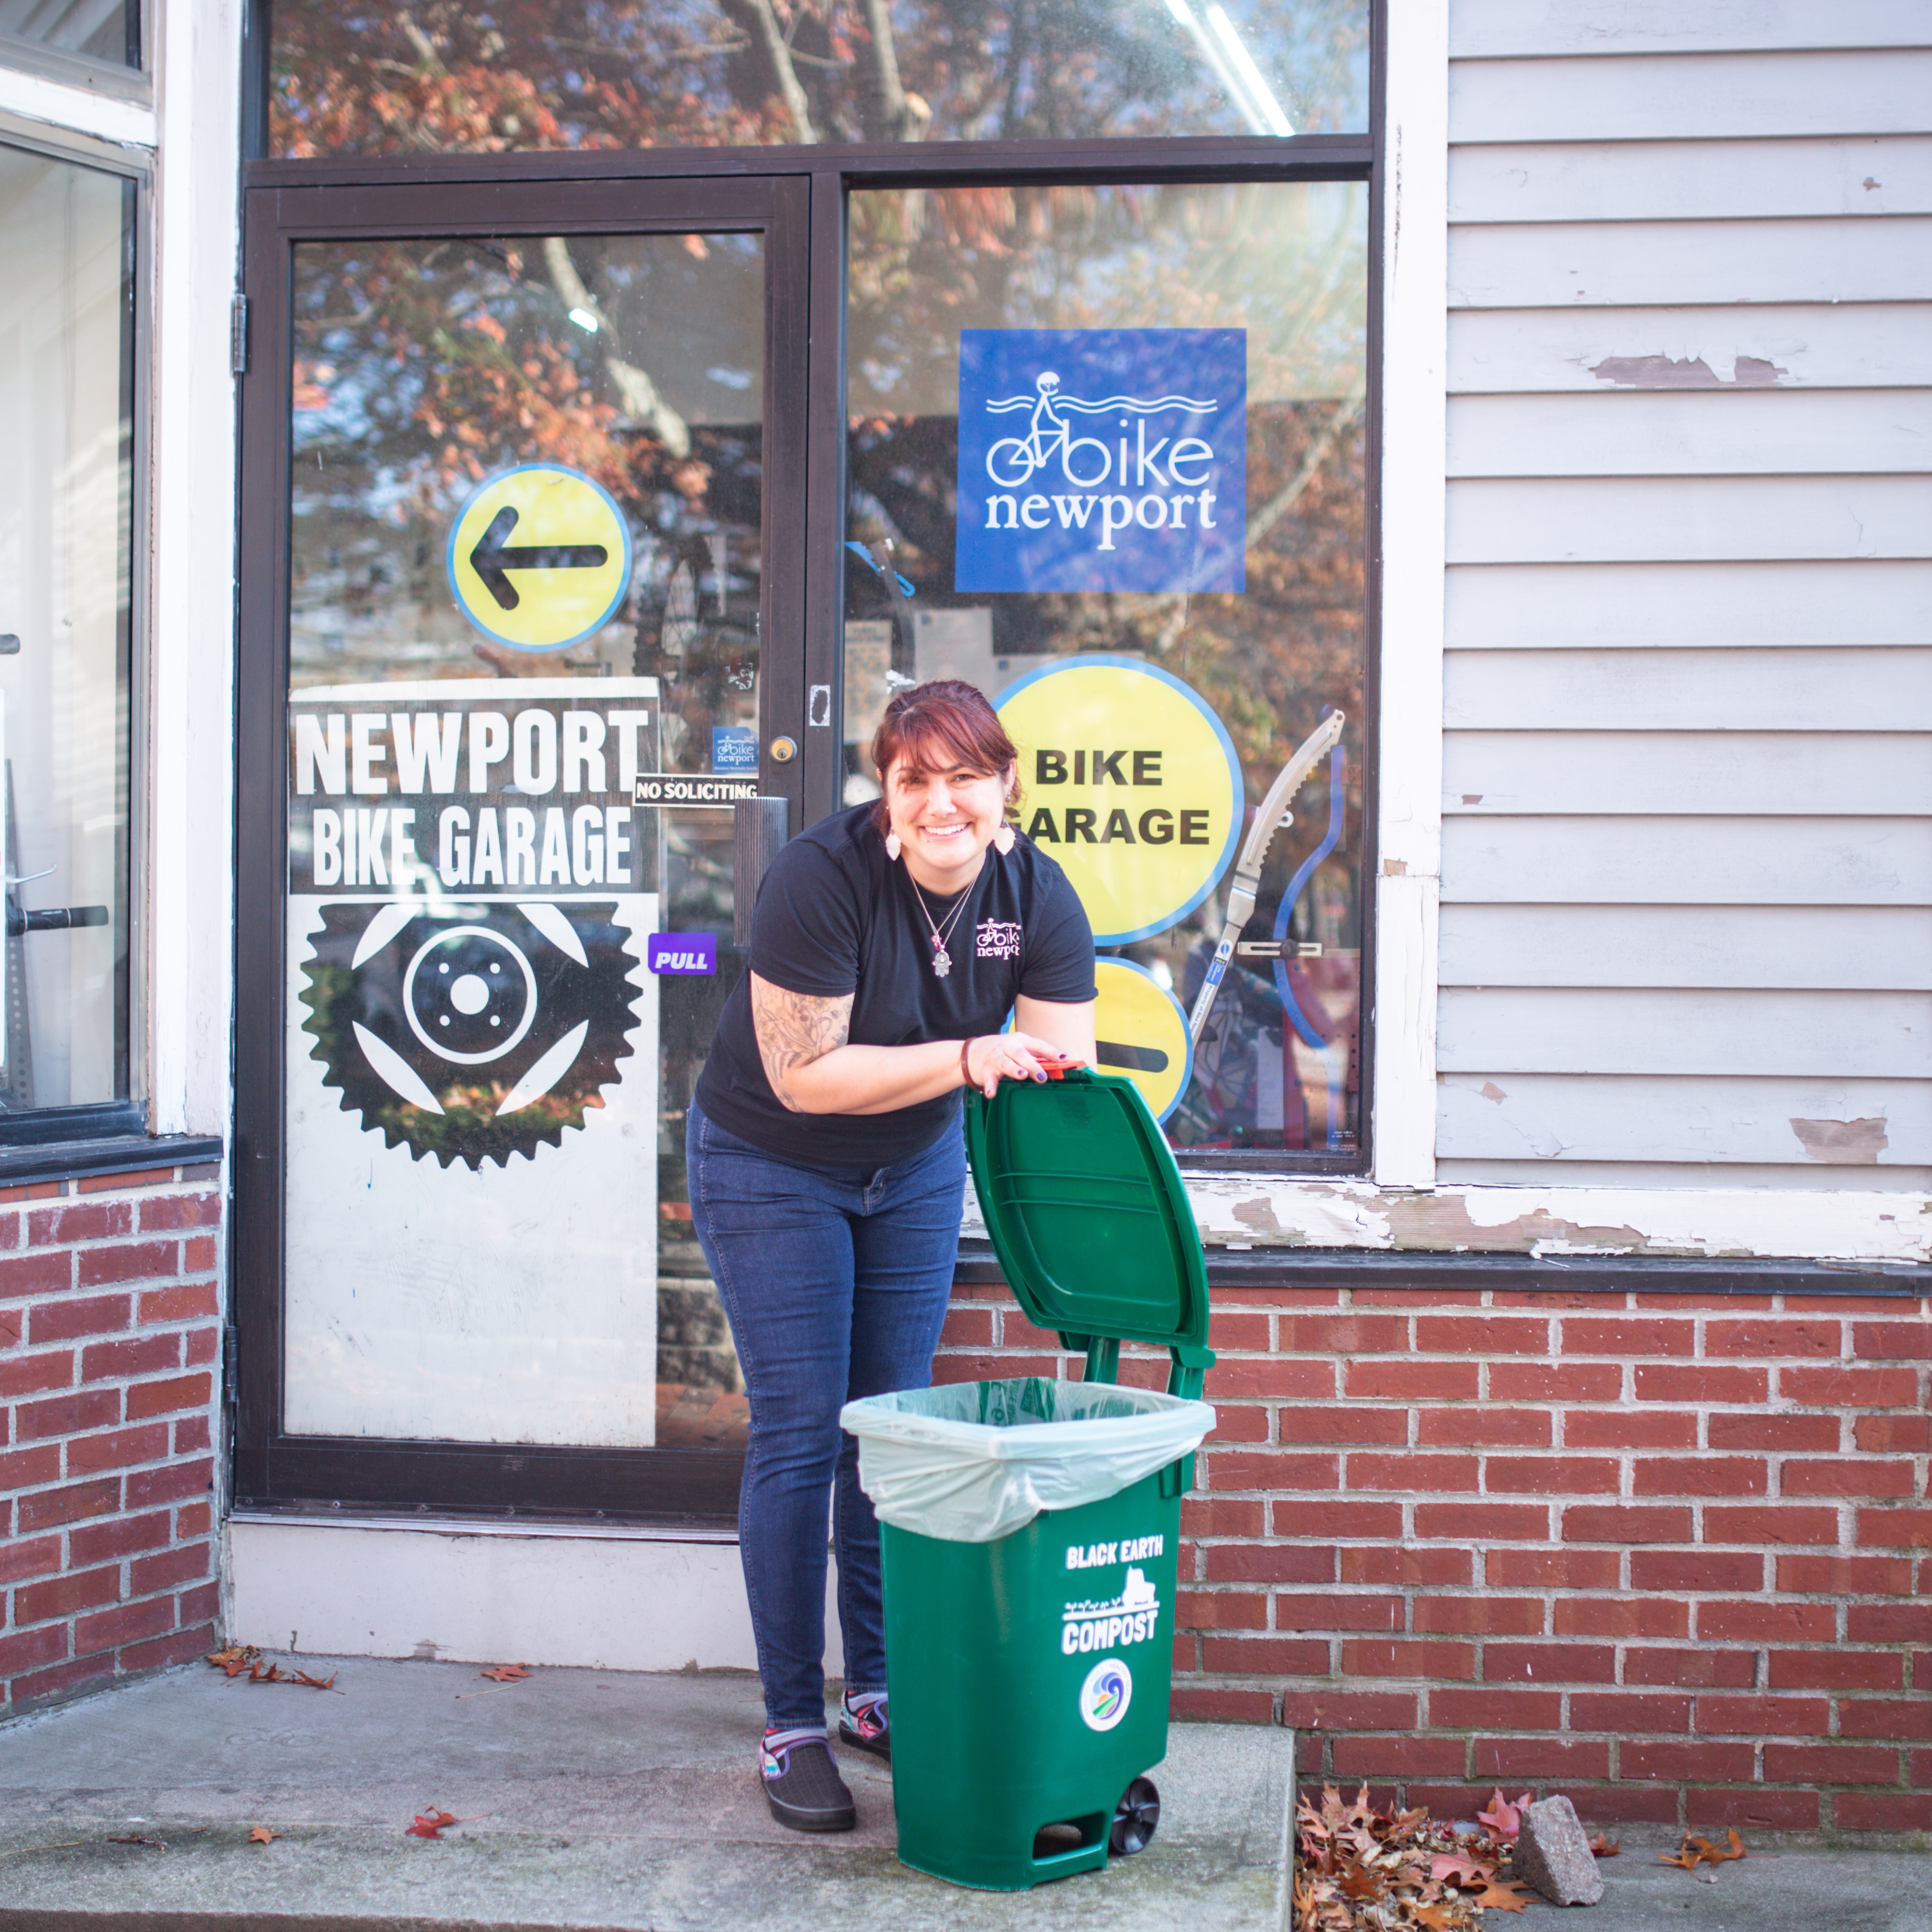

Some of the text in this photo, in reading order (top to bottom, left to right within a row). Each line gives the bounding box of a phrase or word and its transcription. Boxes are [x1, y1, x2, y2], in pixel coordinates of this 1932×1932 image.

[1062, 419, 1214, 487] bike
[985, 488, 1217, 550] newport
[296, 709, 649, 795] NEWPORT
[718, 755, 755, 765] newport
[730, 744, 754, 755] bike
[1036, 749, 1163, 786] BIKE
[636, 782, 757, 800] NO SOLICITING
[1004, 808, 1210, 845] ARAGE
[314, 805, 631, 887] BIKE GARAGE
[655, 952, 708, 970] PULL
[1201, 985, 1213, 1005] Property
[1066, 1534, 1164, 1570] BLACK EARTH
[1061, 1609, 1159, 1655] COMPOST
